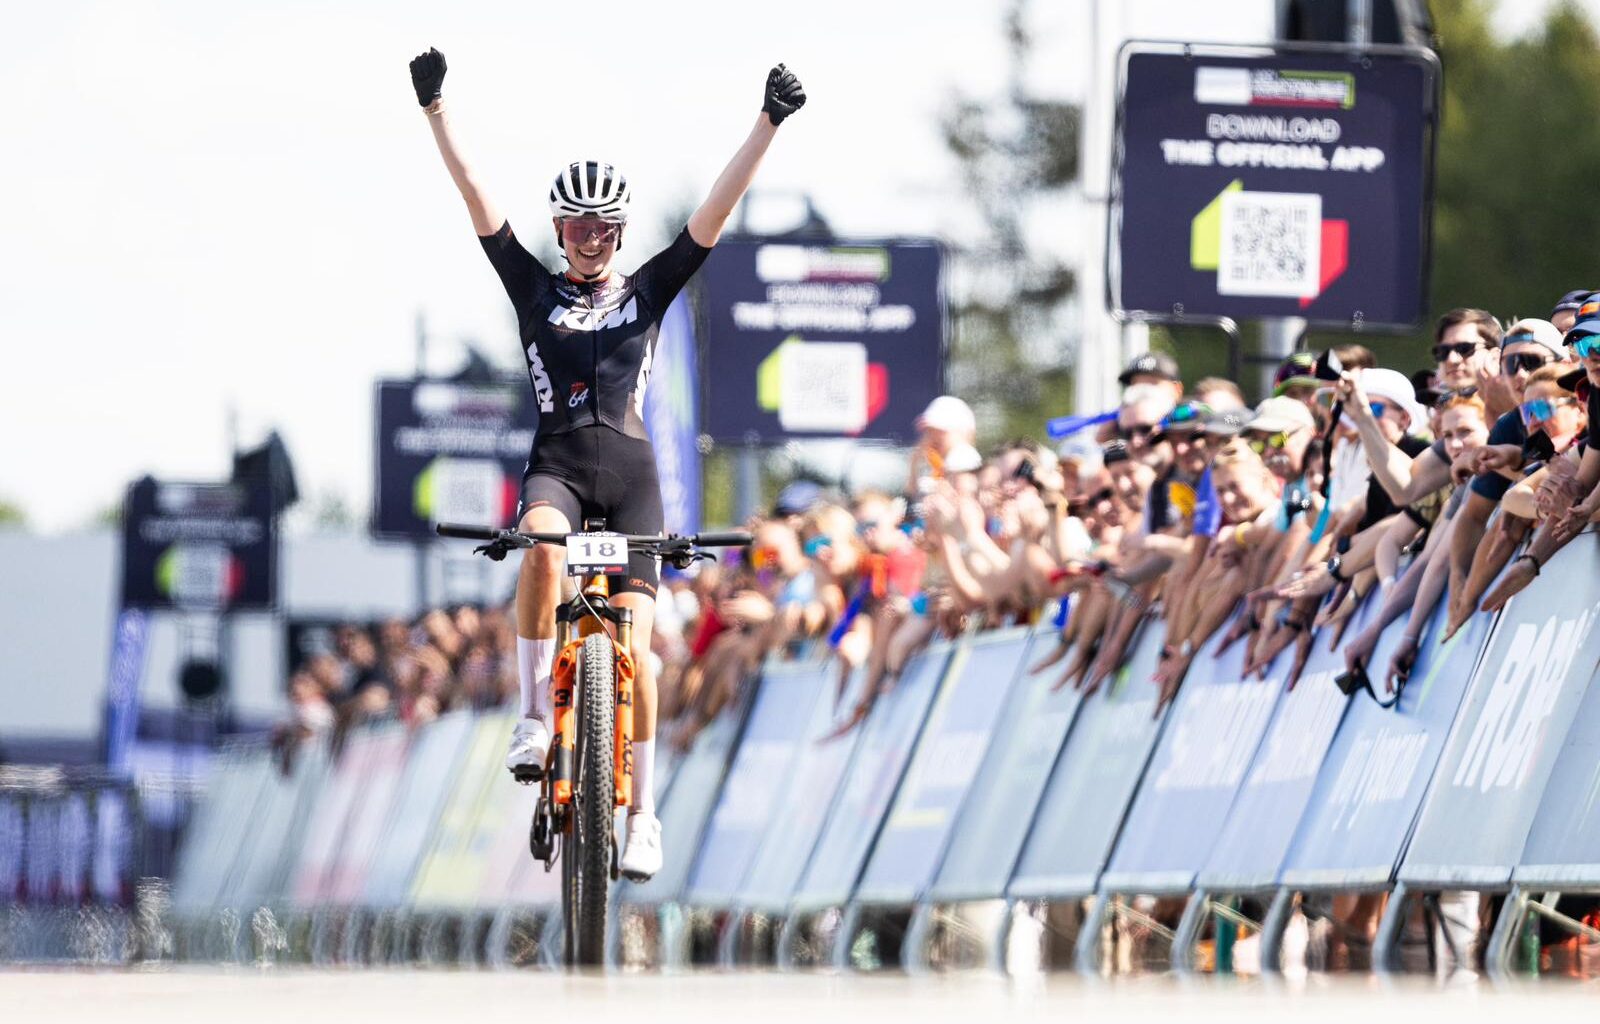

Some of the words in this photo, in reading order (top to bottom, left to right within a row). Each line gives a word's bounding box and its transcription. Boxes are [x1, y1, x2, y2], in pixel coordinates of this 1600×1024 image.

[1206, 113, 1341, 143] DOWNLOAD
[1160, 138, 1214, 165] THE
[1216, 141, 1329, 170] OFFICIAL
[1330, 146, 1386, 172] APP
[547, 295, 638, 331] KTM
[527, 342, 554, 412] KTM
[568, 388, 589, 407] 64
[580, 542, 616, 557] 18
